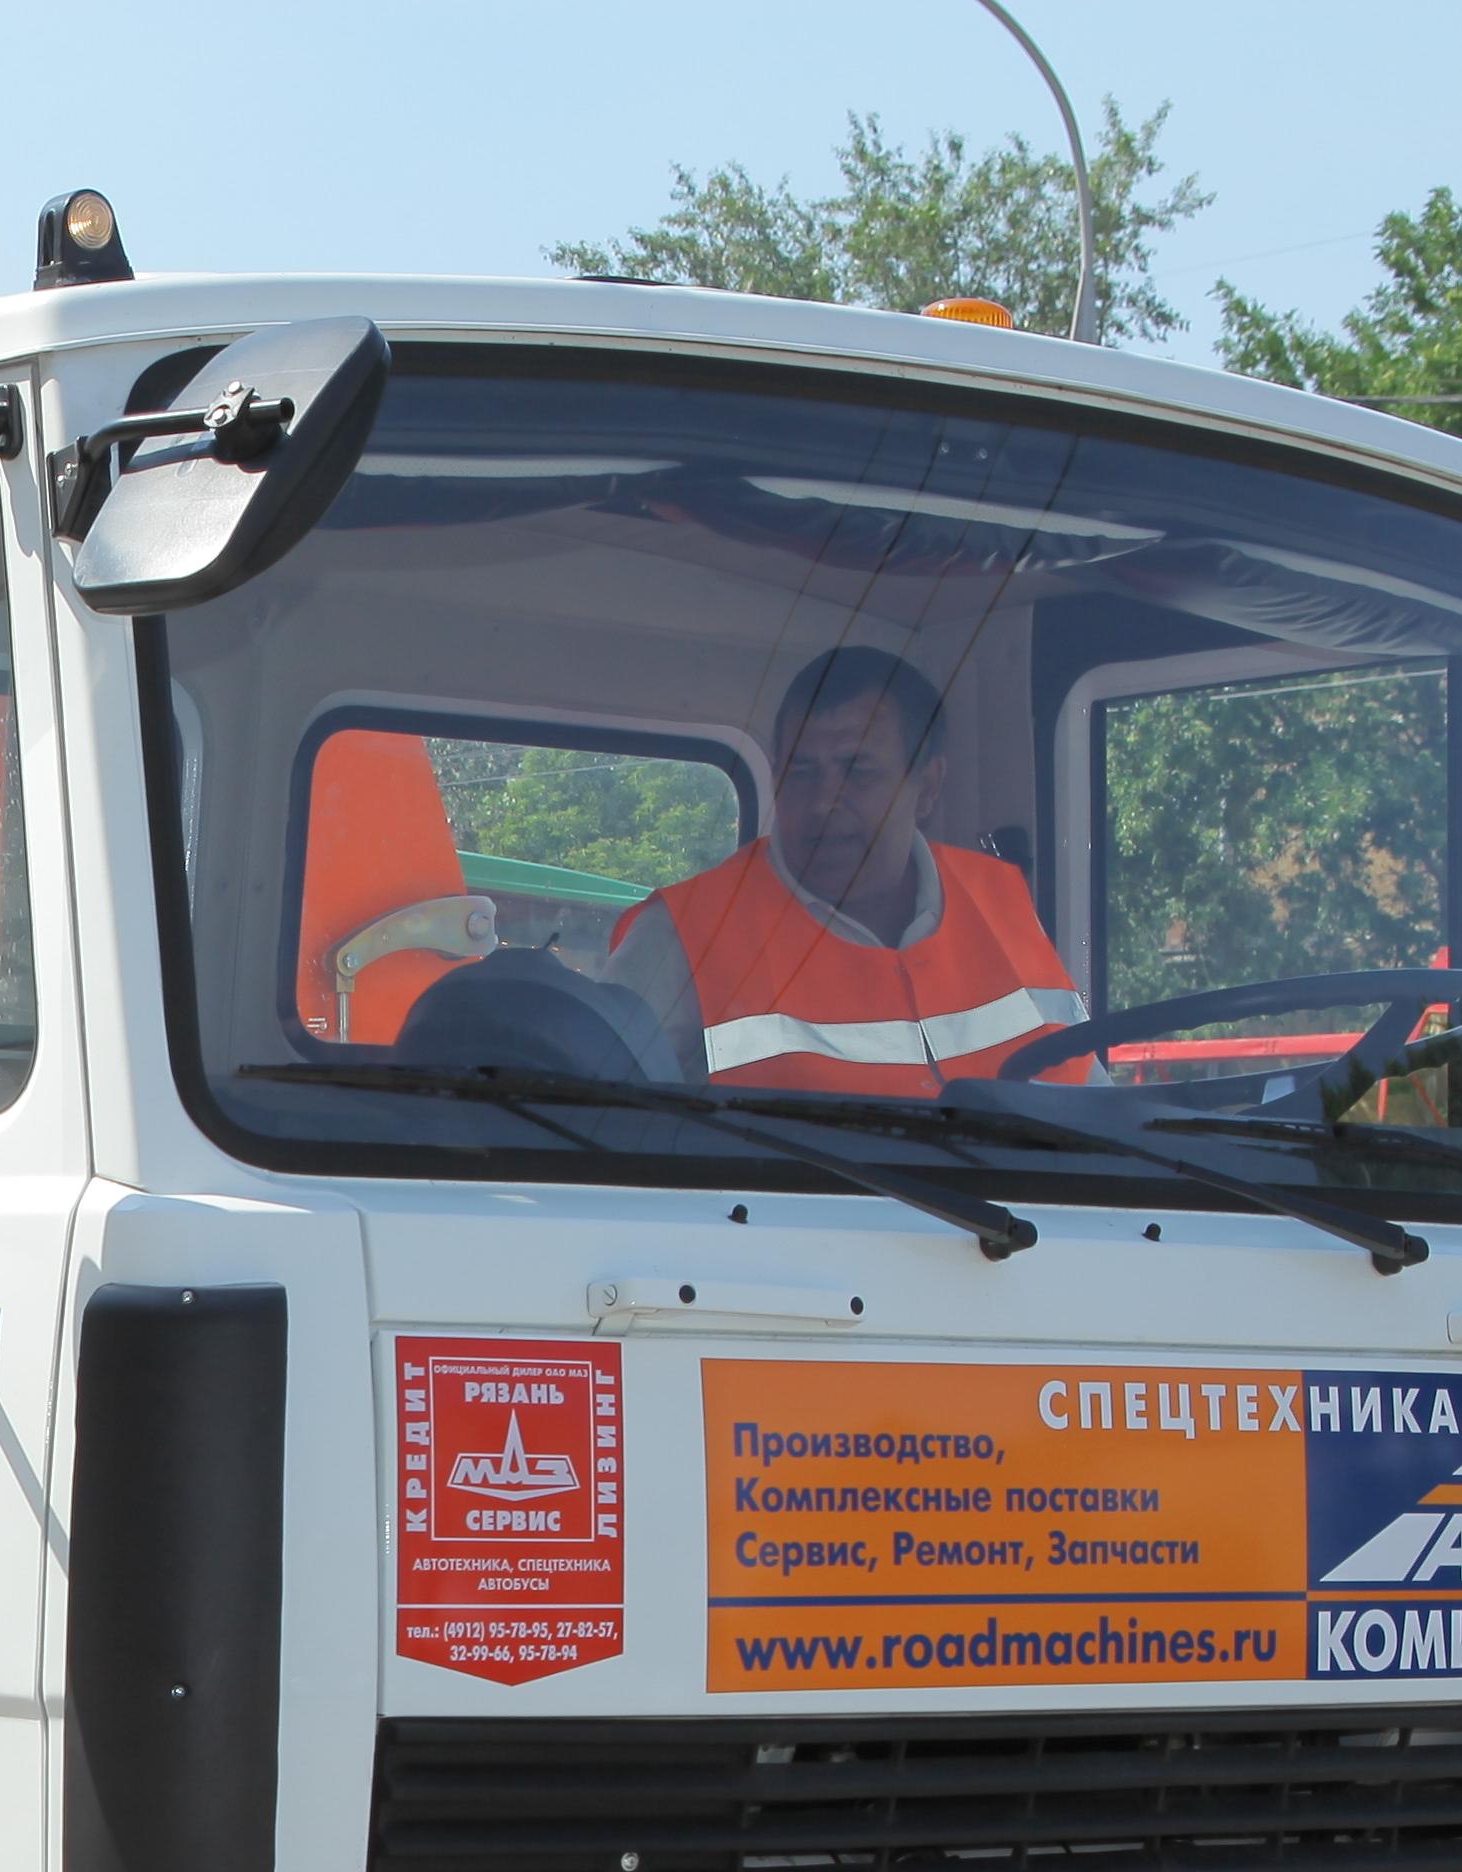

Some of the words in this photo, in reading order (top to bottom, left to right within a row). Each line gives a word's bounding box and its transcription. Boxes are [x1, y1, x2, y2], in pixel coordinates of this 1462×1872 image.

[434, 1364, 510, 1377] ОФИЦИАЛЬНЫЙ
[512, 1367, 543, 1378] ДИЛЕР
[545, 1368, 566, 1378] ОАО
[568, 1368, 589, 1379] МАЗ
[464, 1381, 565, 1405] РЯЗАНЬ
[1038, 1379, 1460, 1440] СПЕЦТЕХНИКА
[404, 1362, 430, 1532] КРЕДИТ
[595, 1369, 618, 1538] ЛИЗИНГ
[732, 1421, 1006, 1468] Производство,
[734, 1476, 993, 1513] Комплексные
[1005, 1485, 1160, 1513] поставки
[466, 1509, 562, 1532] СЕРВИС
[412, 1557, 514, 1574] АВТОТЕХНИКА,
[517, 1558, 612, 1574] СПЕЦТЕХНИКА
[734, 1530, 879, 1577] Сервис,
[892, 1530, 1035, 1572] Ремонт,
[1047, 1529, 1200, 1566] Запчасти
[477, 1577, 550, 1591] АВТОБУСЫ
[406, 1626, 440, 1639] тел.:
[443, 1620, 485, 1642] (4912)
[488, 1622, 553, 1641] 95-78-95,
[556, 1621, 619, 1640] 27-82-57,
[734, 1614, 1278, 1672] www.roadmachines.ru
[1316, 1607, 1462, 1673] КОМ
[449, 1645, 515, 1664] 32-99-66,
[518, 1645, 578, 1661] 95-78-94
